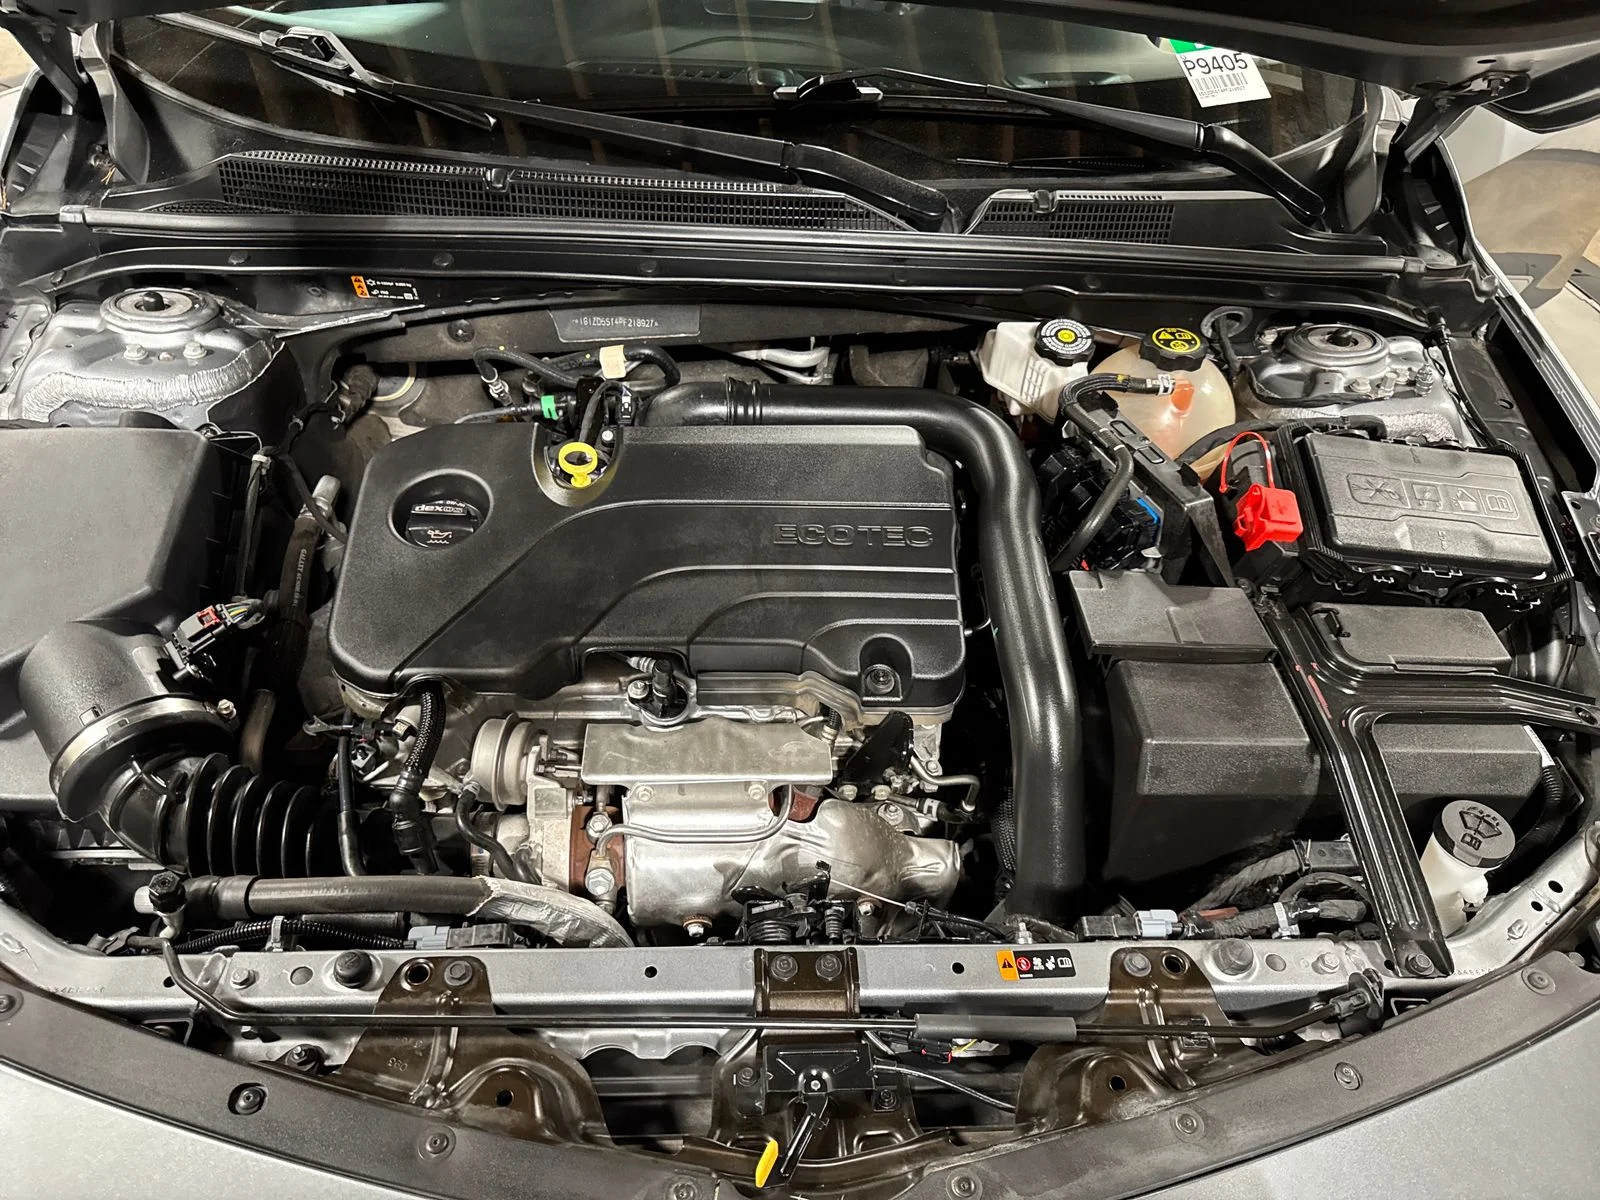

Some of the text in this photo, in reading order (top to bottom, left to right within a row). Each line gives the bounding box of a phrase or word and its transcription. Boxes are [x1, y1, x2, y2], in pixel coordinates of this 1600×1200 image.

[1182, 52, 1248, 77] P9405
[414, 504, 463, 513] dexos
[773, 523, 934, 548] ECOTEC
